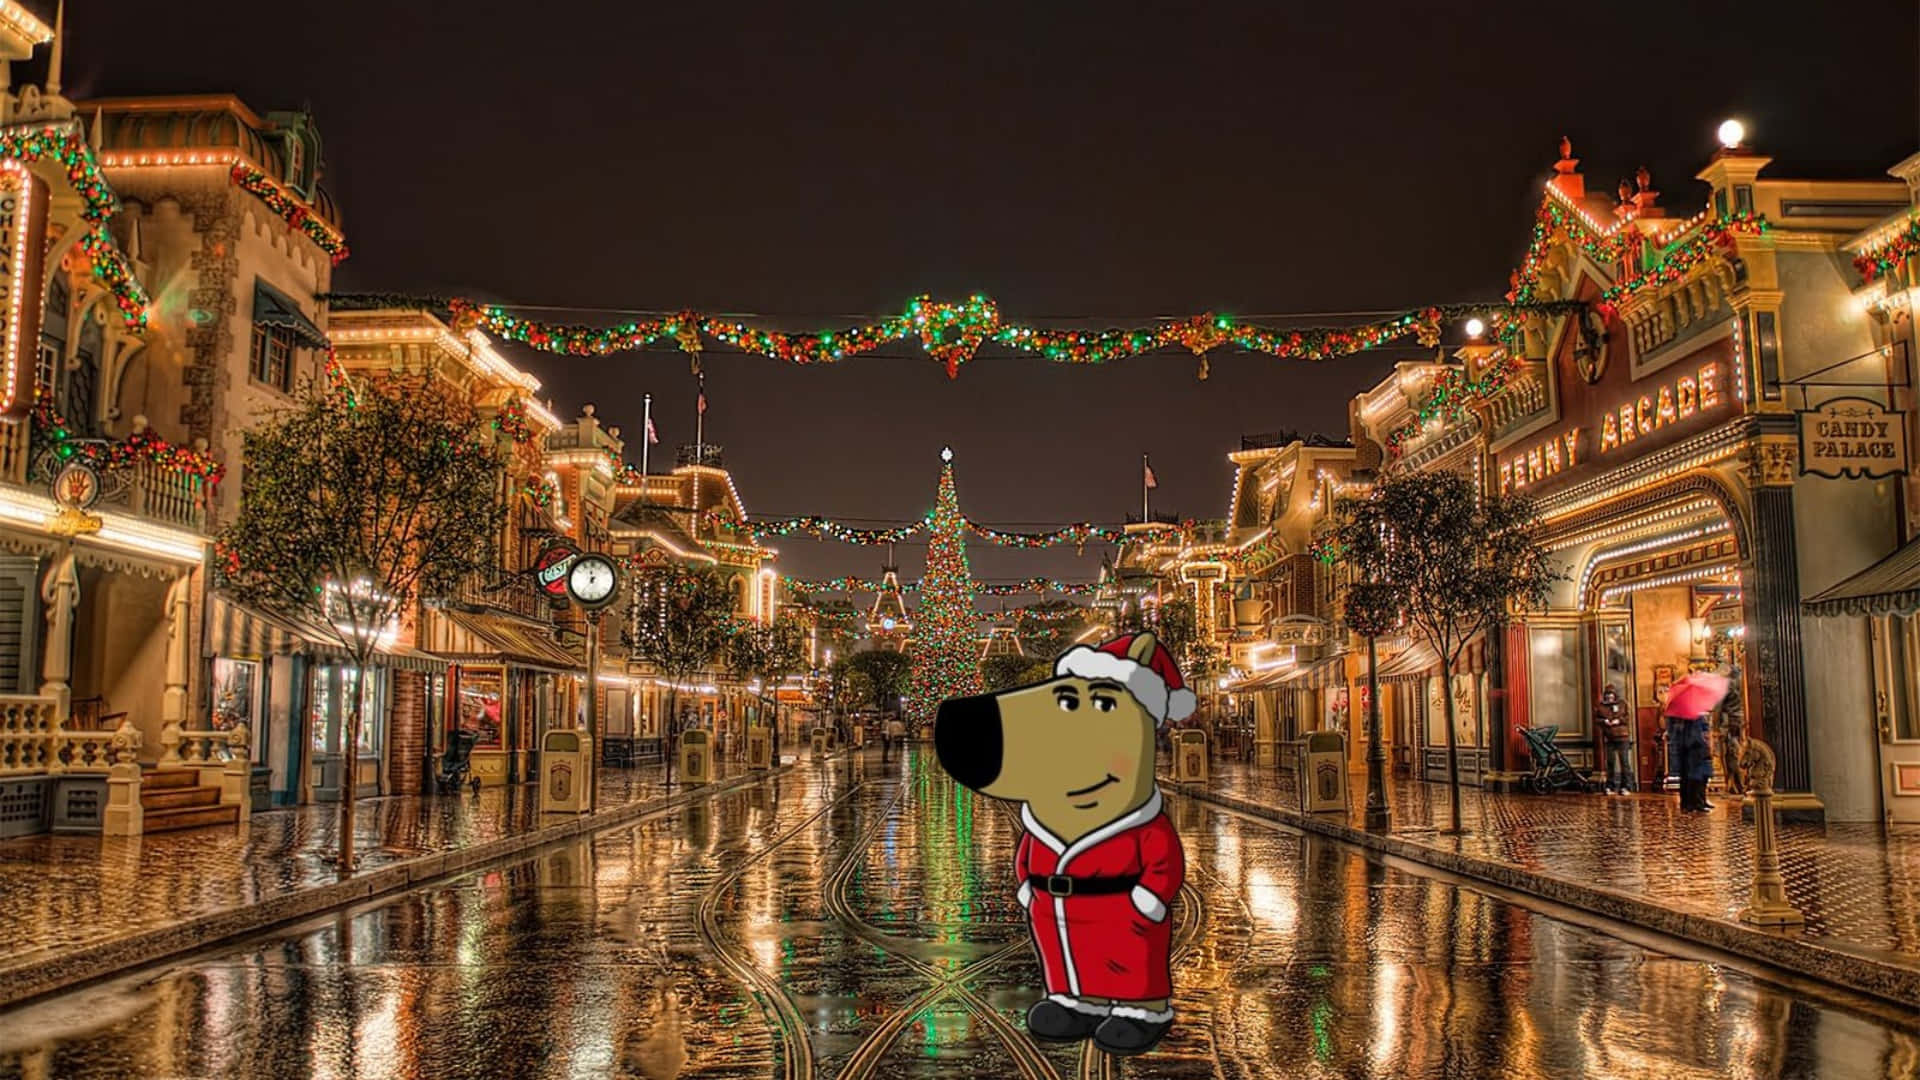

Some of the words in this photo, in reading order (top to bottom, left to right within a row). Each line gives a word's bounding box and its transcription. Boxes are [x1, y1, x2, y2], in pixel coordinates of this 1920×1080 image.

[1500, 427, 1580, 495] PENNY
[1600, 361, 1719, 453] ARCADE
[1816, 422, 1889, 438] CANDY
[1812, 441, 1896, 459] PALACE
